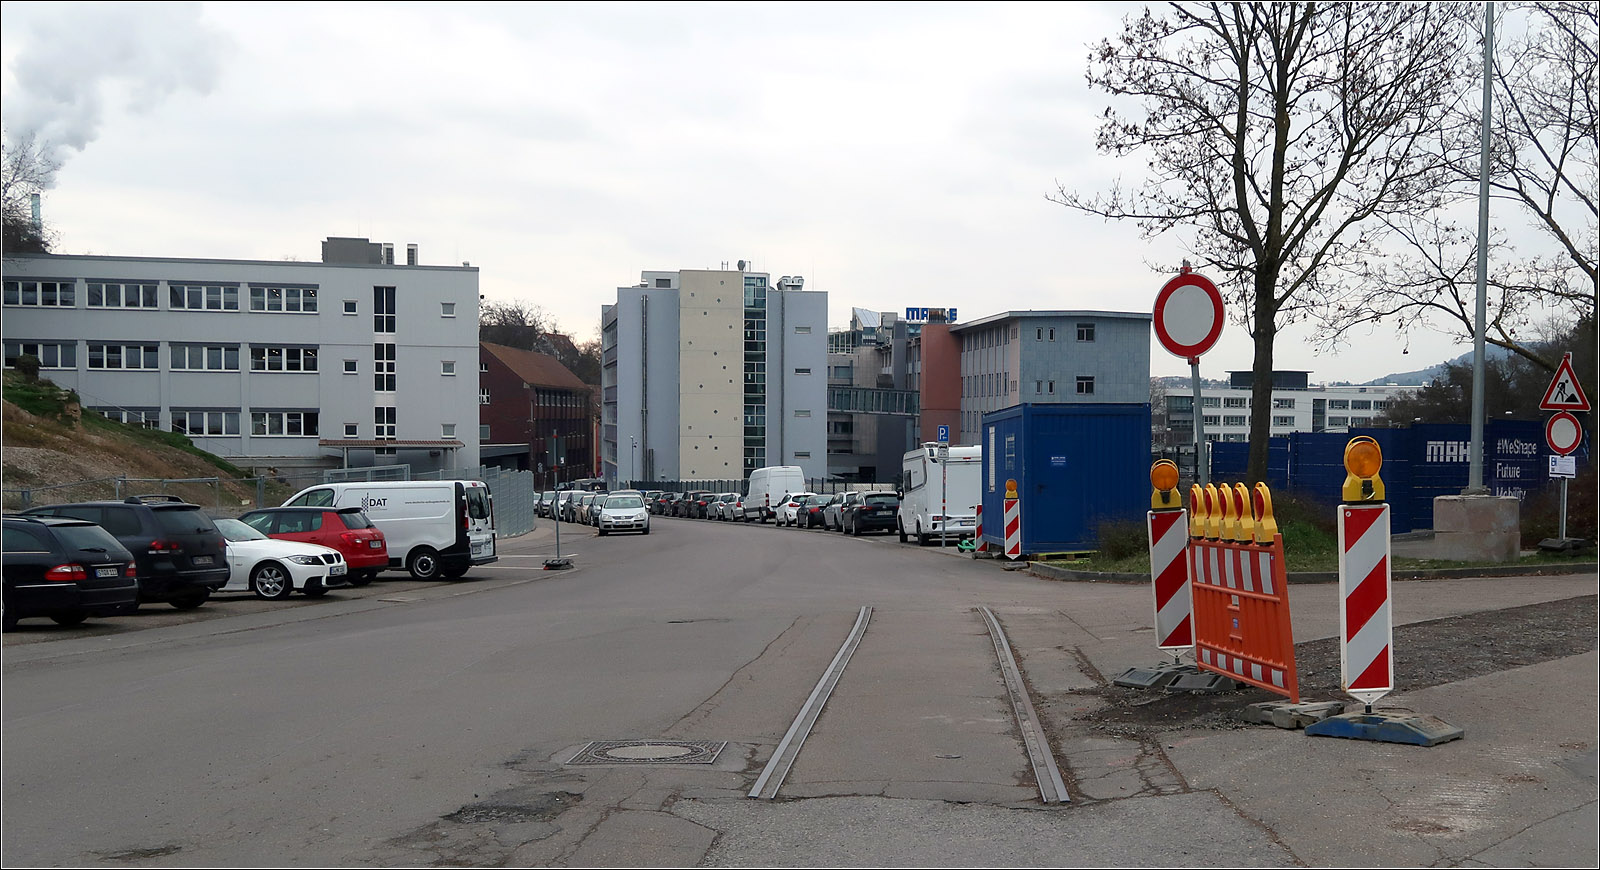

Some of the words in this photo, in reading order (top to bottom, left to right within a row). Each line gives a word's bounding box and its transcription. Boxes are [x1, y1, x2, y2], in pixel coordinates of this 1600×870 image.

[906, 307, 957, 320] MAE
[940, 428, 946, 440] P
[1426, 441, 1484, 462] MAH
[1496, 439, 1537, 458] #WeShape
[1496, 462, 1521, 478] Future
[370, 498, 388, 507] DAT
